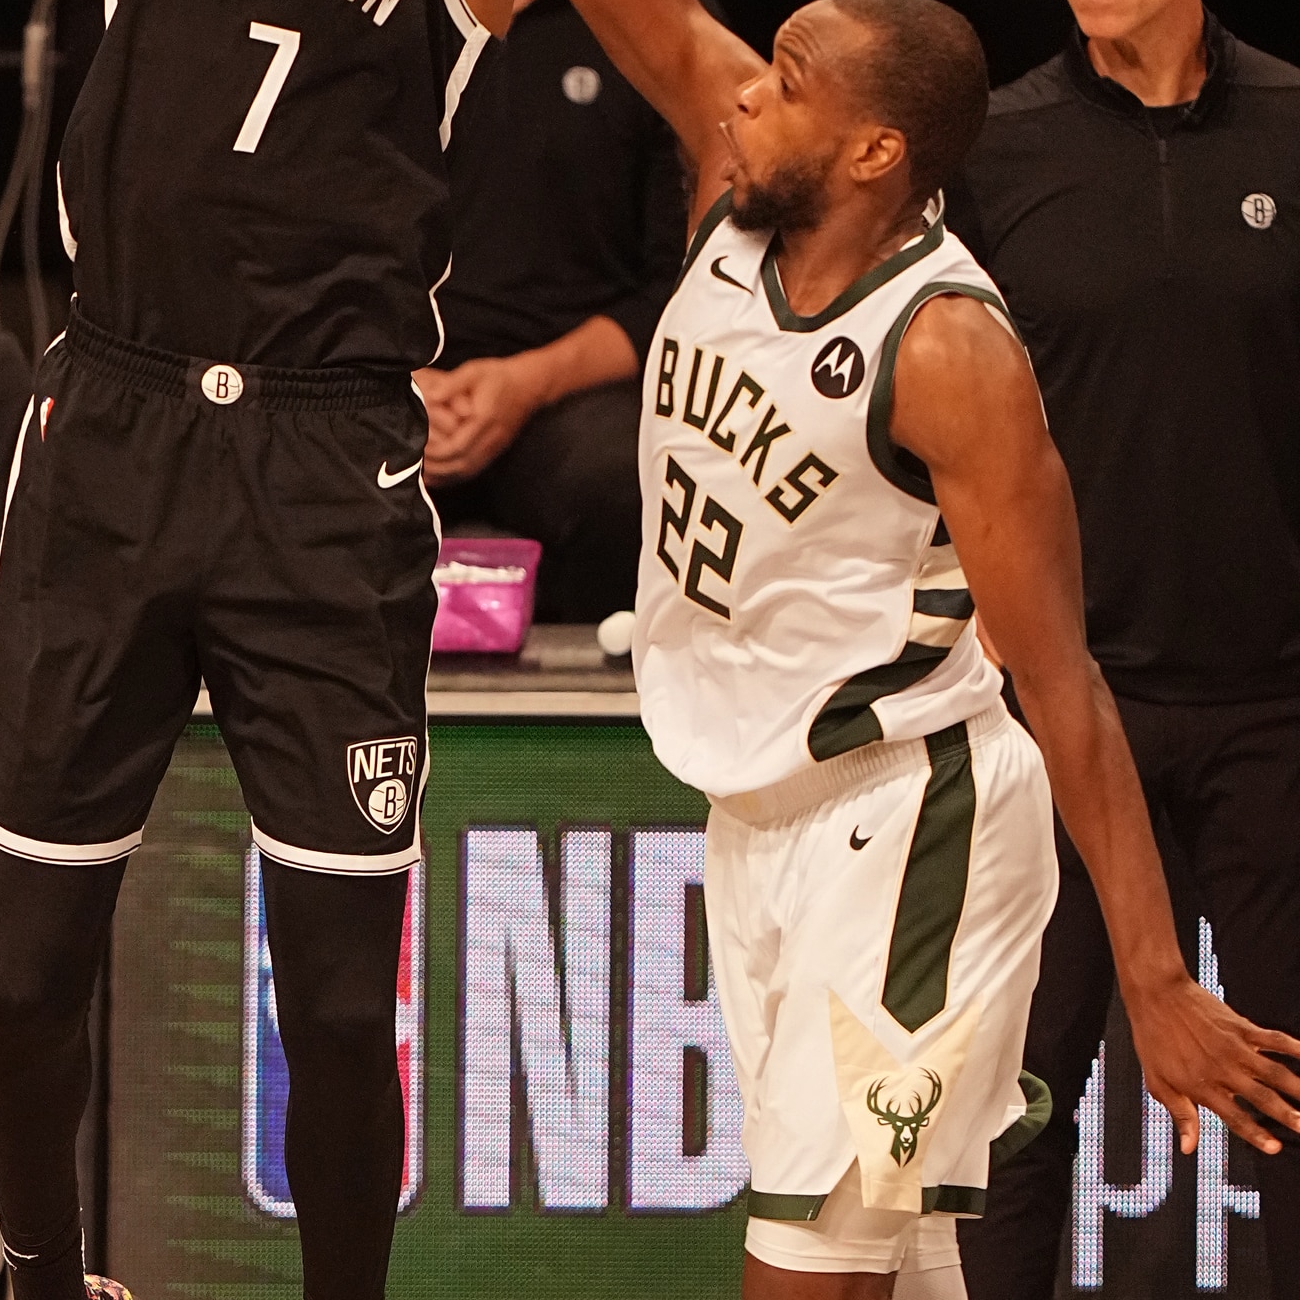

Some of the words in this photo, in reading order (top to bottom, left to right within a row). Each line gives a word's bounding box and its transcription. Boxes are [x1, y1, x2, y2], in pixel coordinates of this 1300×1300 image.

[233, 21, 301, 153] 7
[217, 372, 229, 398] B
[655, 337, 840, 525] BUCKS
[656, 453, 744, 621] 22
[353, 742, 415, 783] NETS
[384, 787, 397, 818] B
